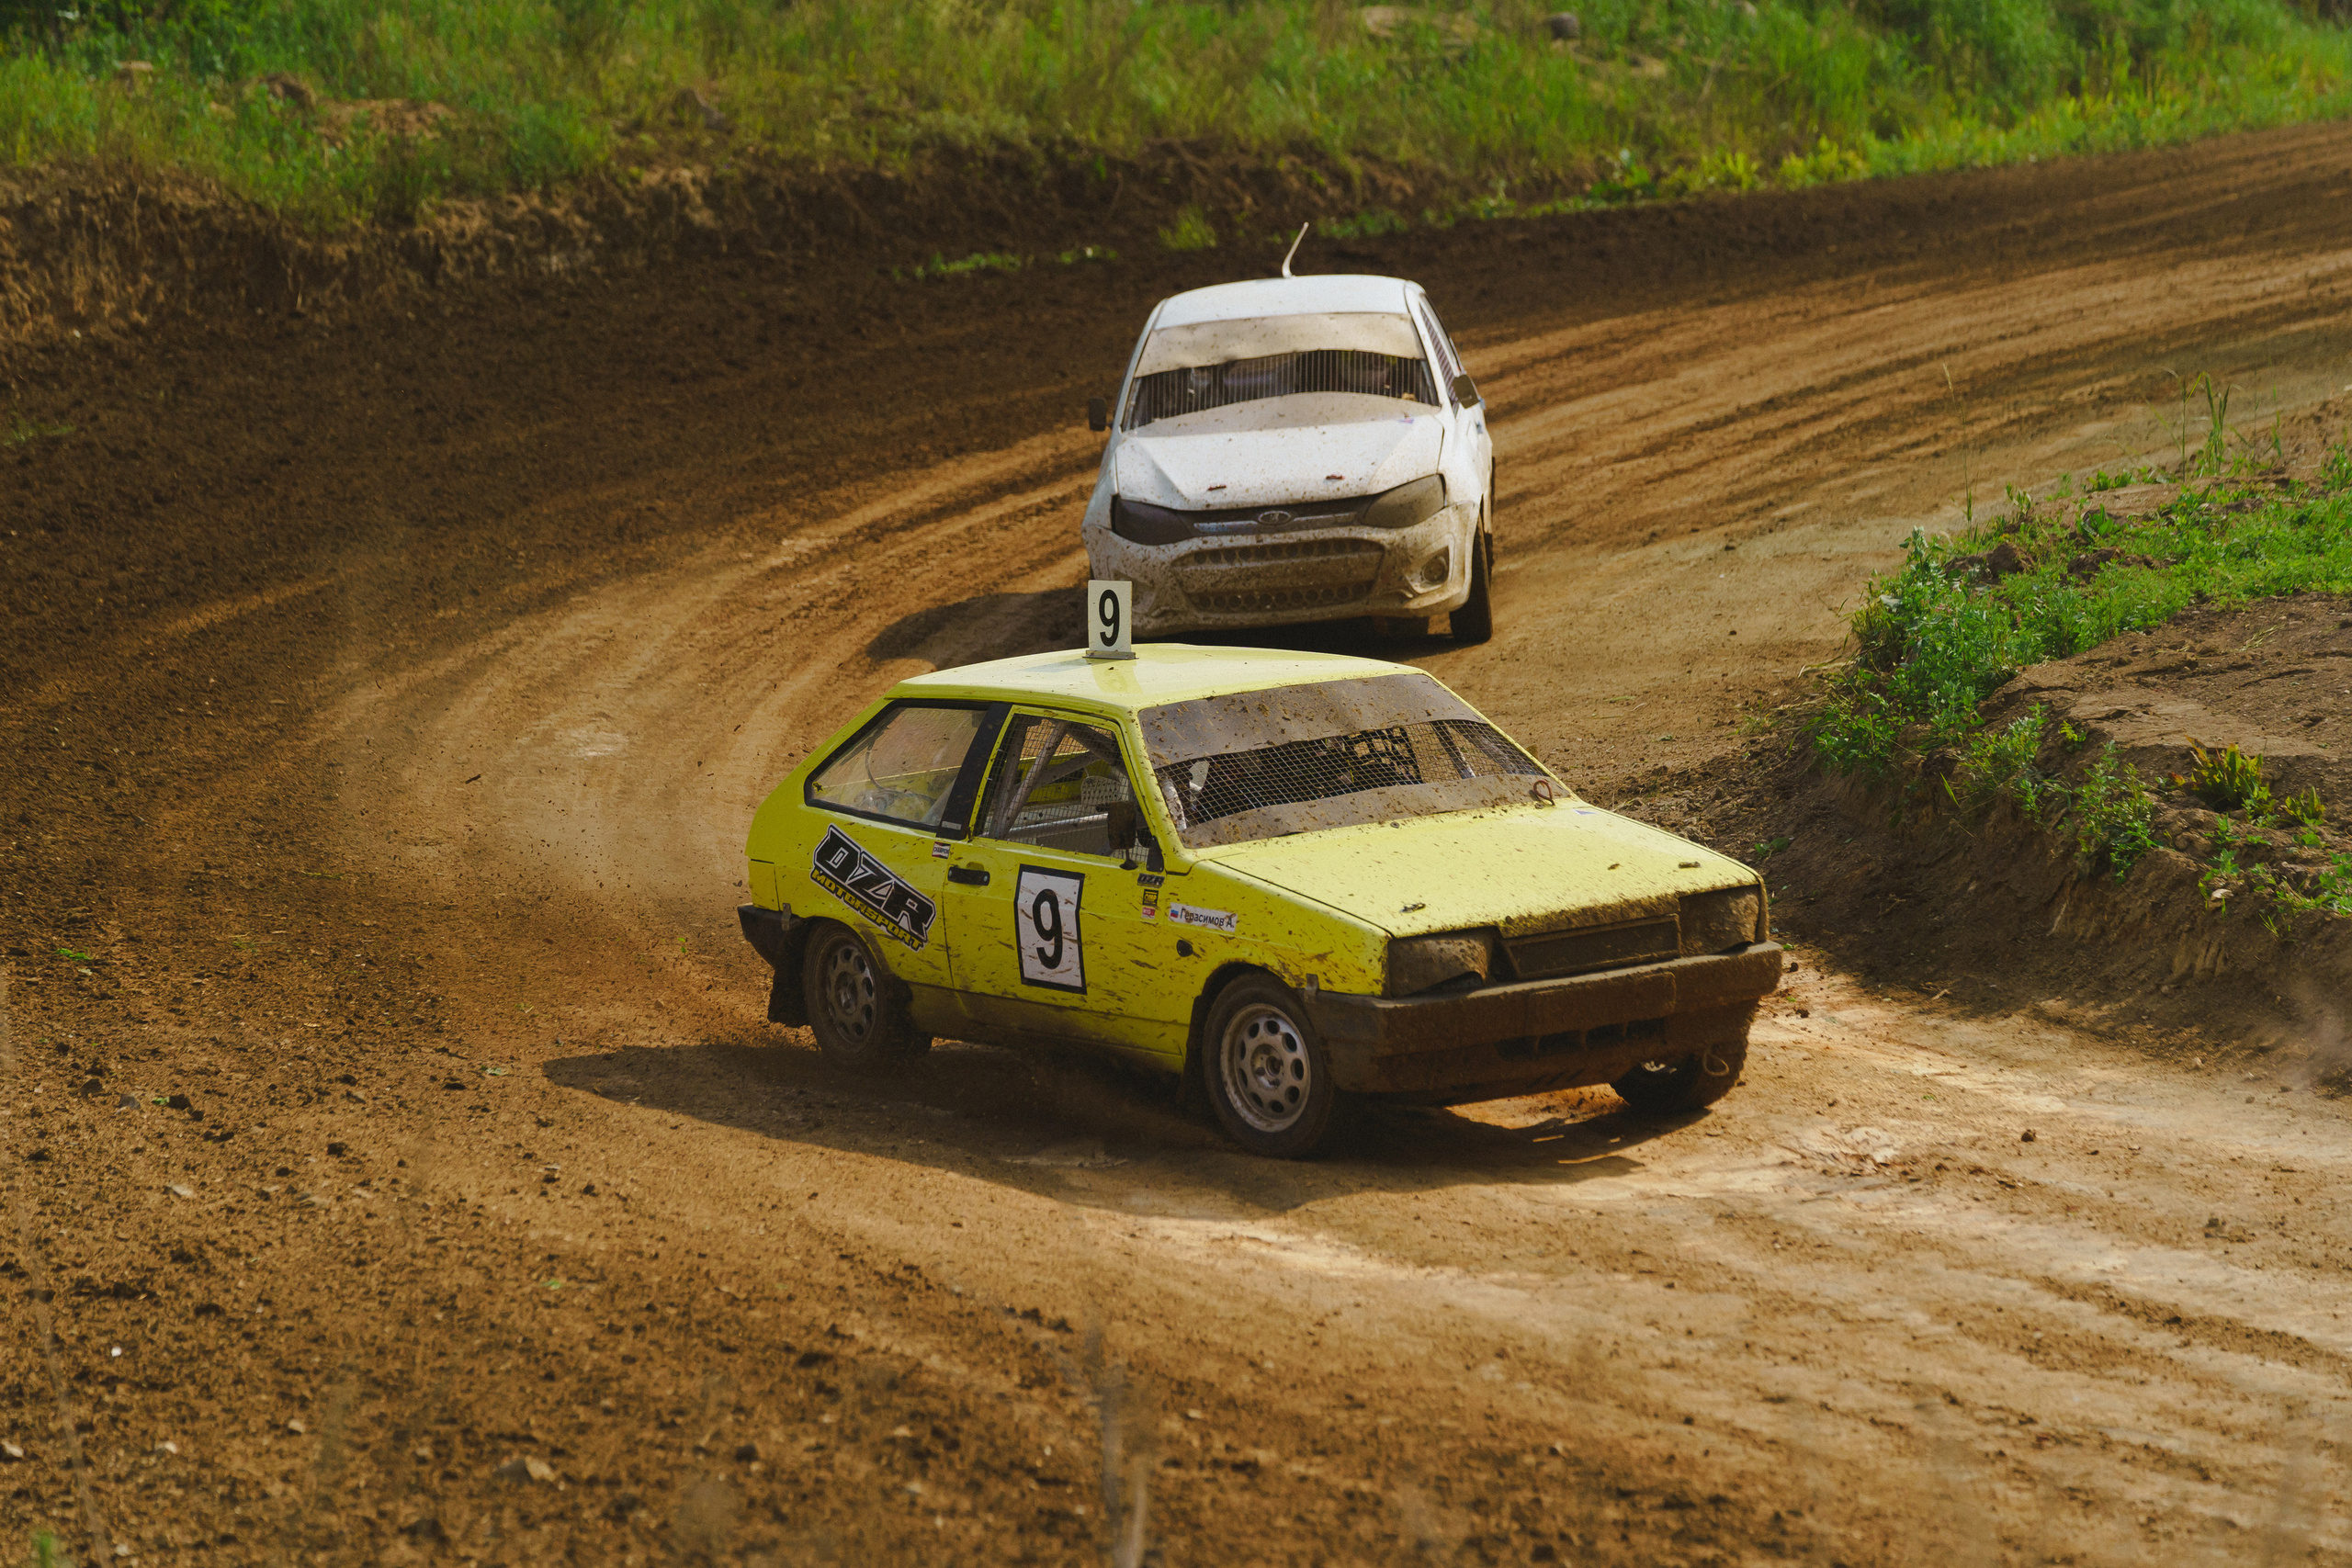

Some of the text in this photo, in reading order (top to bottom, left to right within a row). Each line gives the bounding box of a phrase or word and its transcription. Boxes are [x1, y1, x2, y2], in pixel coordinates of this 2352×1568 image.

[1099, 590, 1120, 647] 9
[811, 869, 922, 951] MOTORSPORT
[815, 827, 933, 941] DZR
[1181, 908, 1225, 927] Герасимов
[1033, 888, 1063, 969] 9
